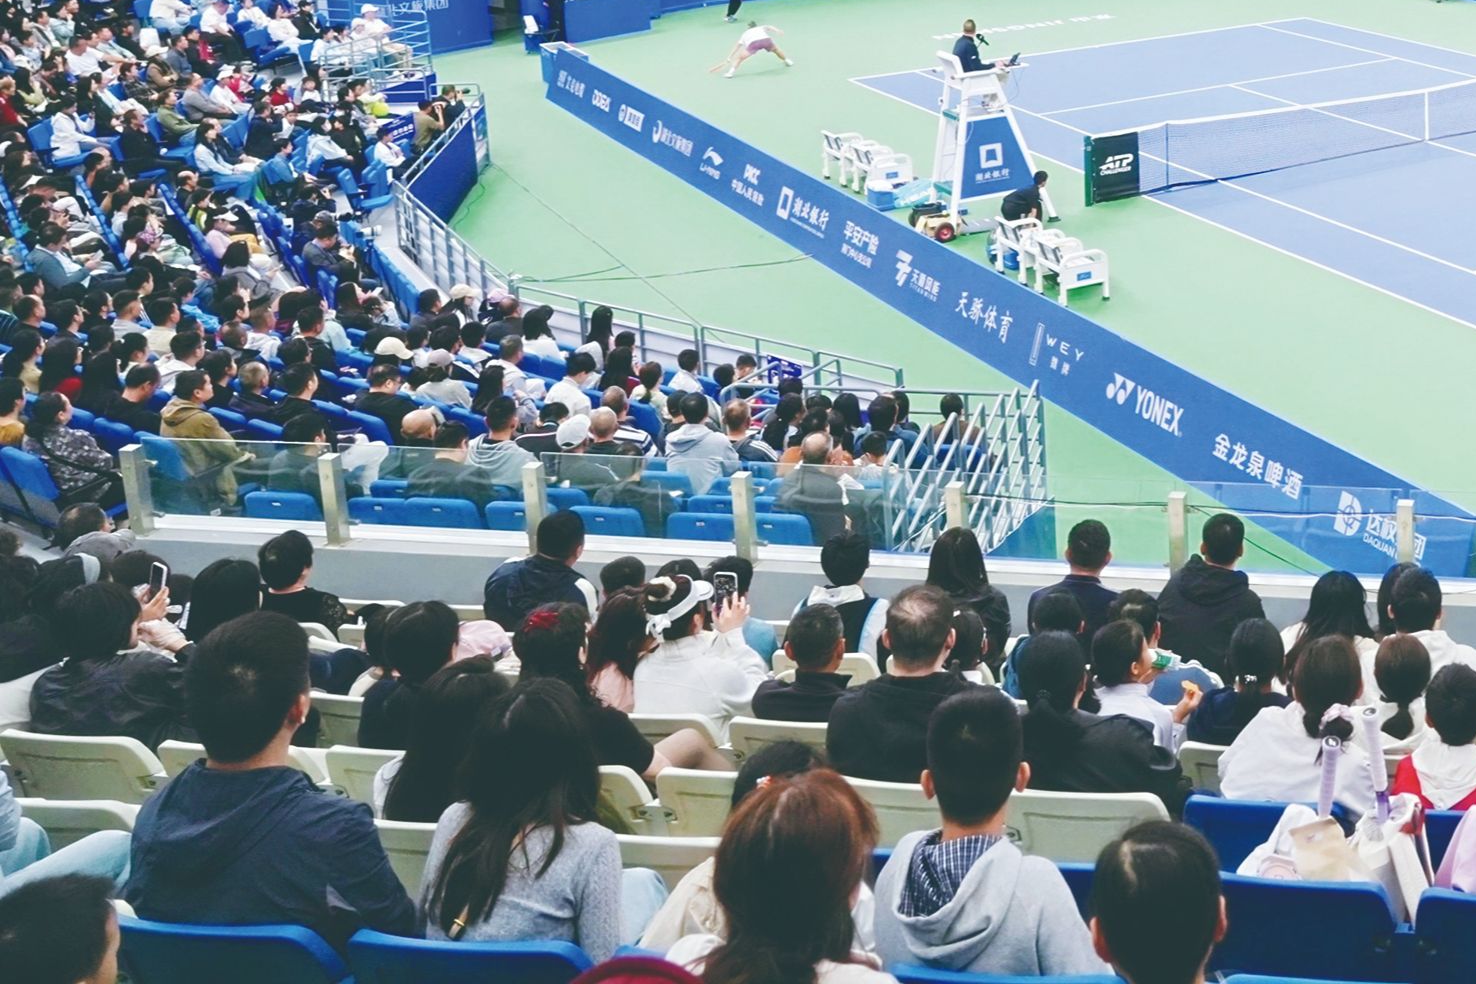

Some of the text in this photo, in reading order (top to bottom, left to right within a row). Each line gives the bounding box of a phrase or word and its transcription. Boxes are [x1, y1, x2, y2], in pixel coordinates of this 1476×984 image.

[743, 164, 761, 185] PICC
[1099, 153, 1134, 170] ATP
[844, 221, 879, 255] 平安产险
[956, 291, 1013, 344] 天骄体育
[1046, 333, 1084, 361] WEY
[1135, 384, 1184, 436] YONEX
[1214, 433, 1303, 501] 金龙泉啤酒
[1362, 532, 1396, 560] DAQUAN
[1365, 508, 1426, 560] 达权团
